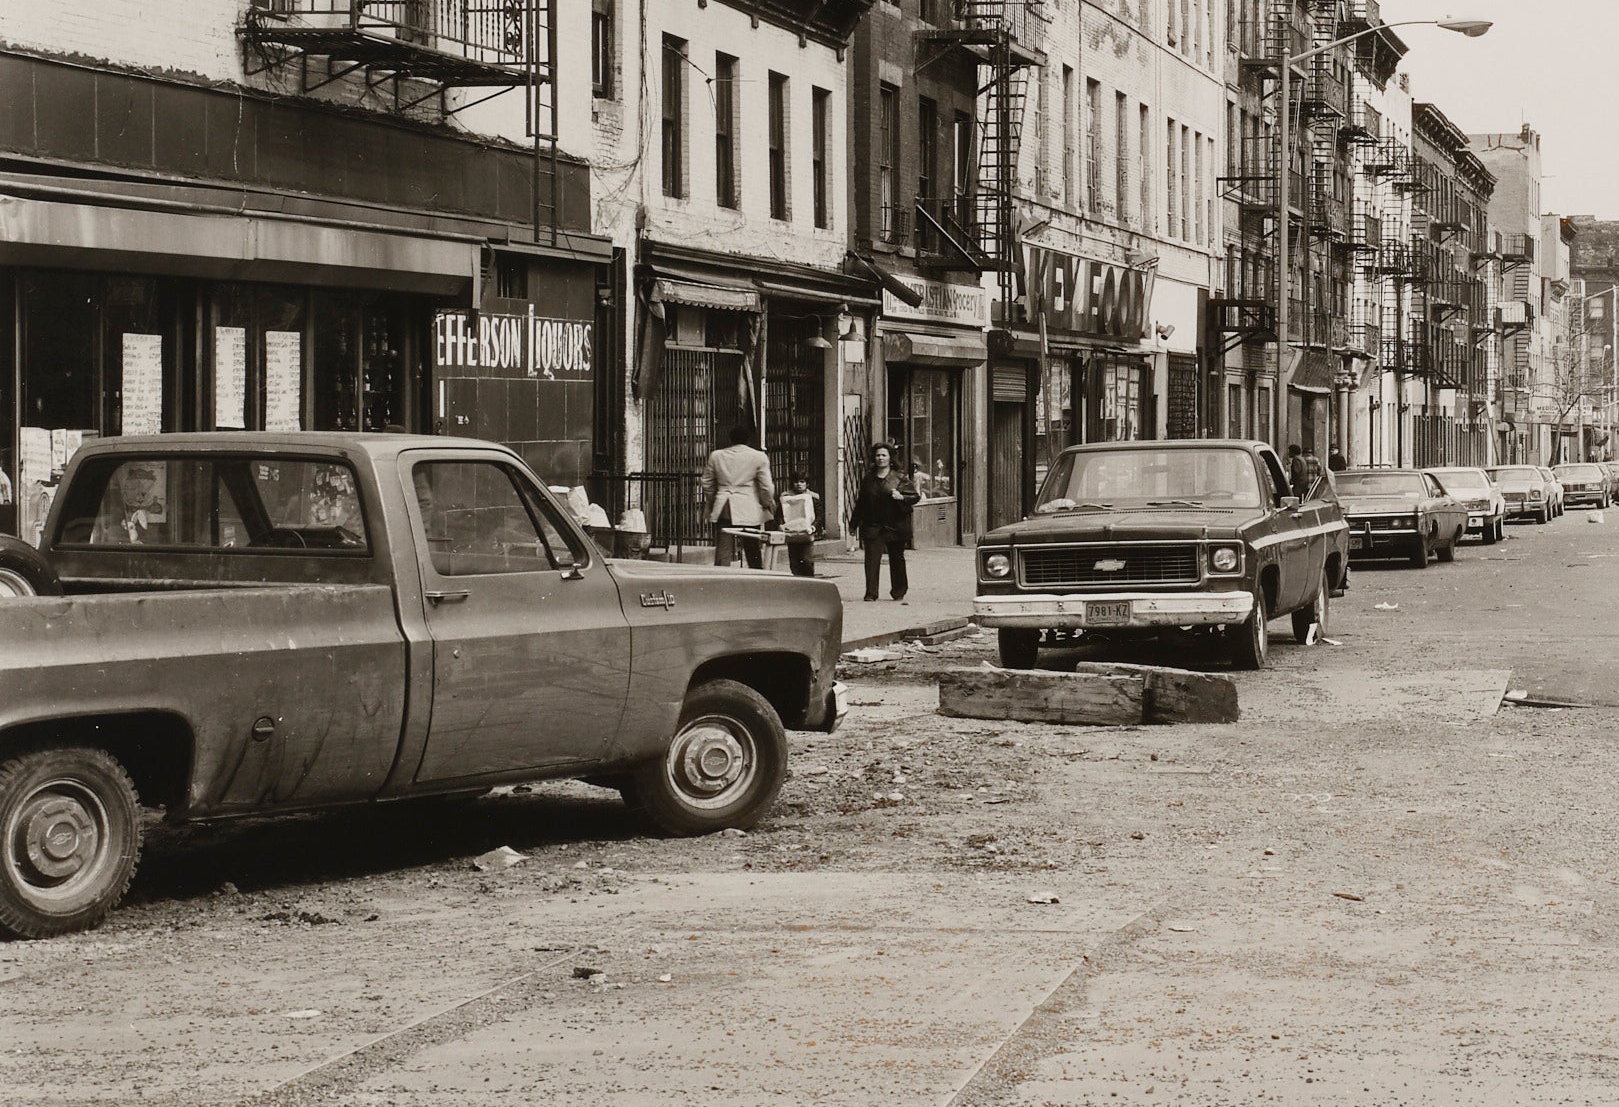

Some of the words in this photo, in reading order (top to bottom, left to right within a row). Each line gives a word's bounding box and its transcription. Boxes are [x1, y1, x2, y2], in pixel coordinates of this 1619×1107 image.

[1028, 246, 1080, 329] KEY
[1084, 261, 1144, 337] FOOD
[528, 303, 592, 380] LIQUORS
